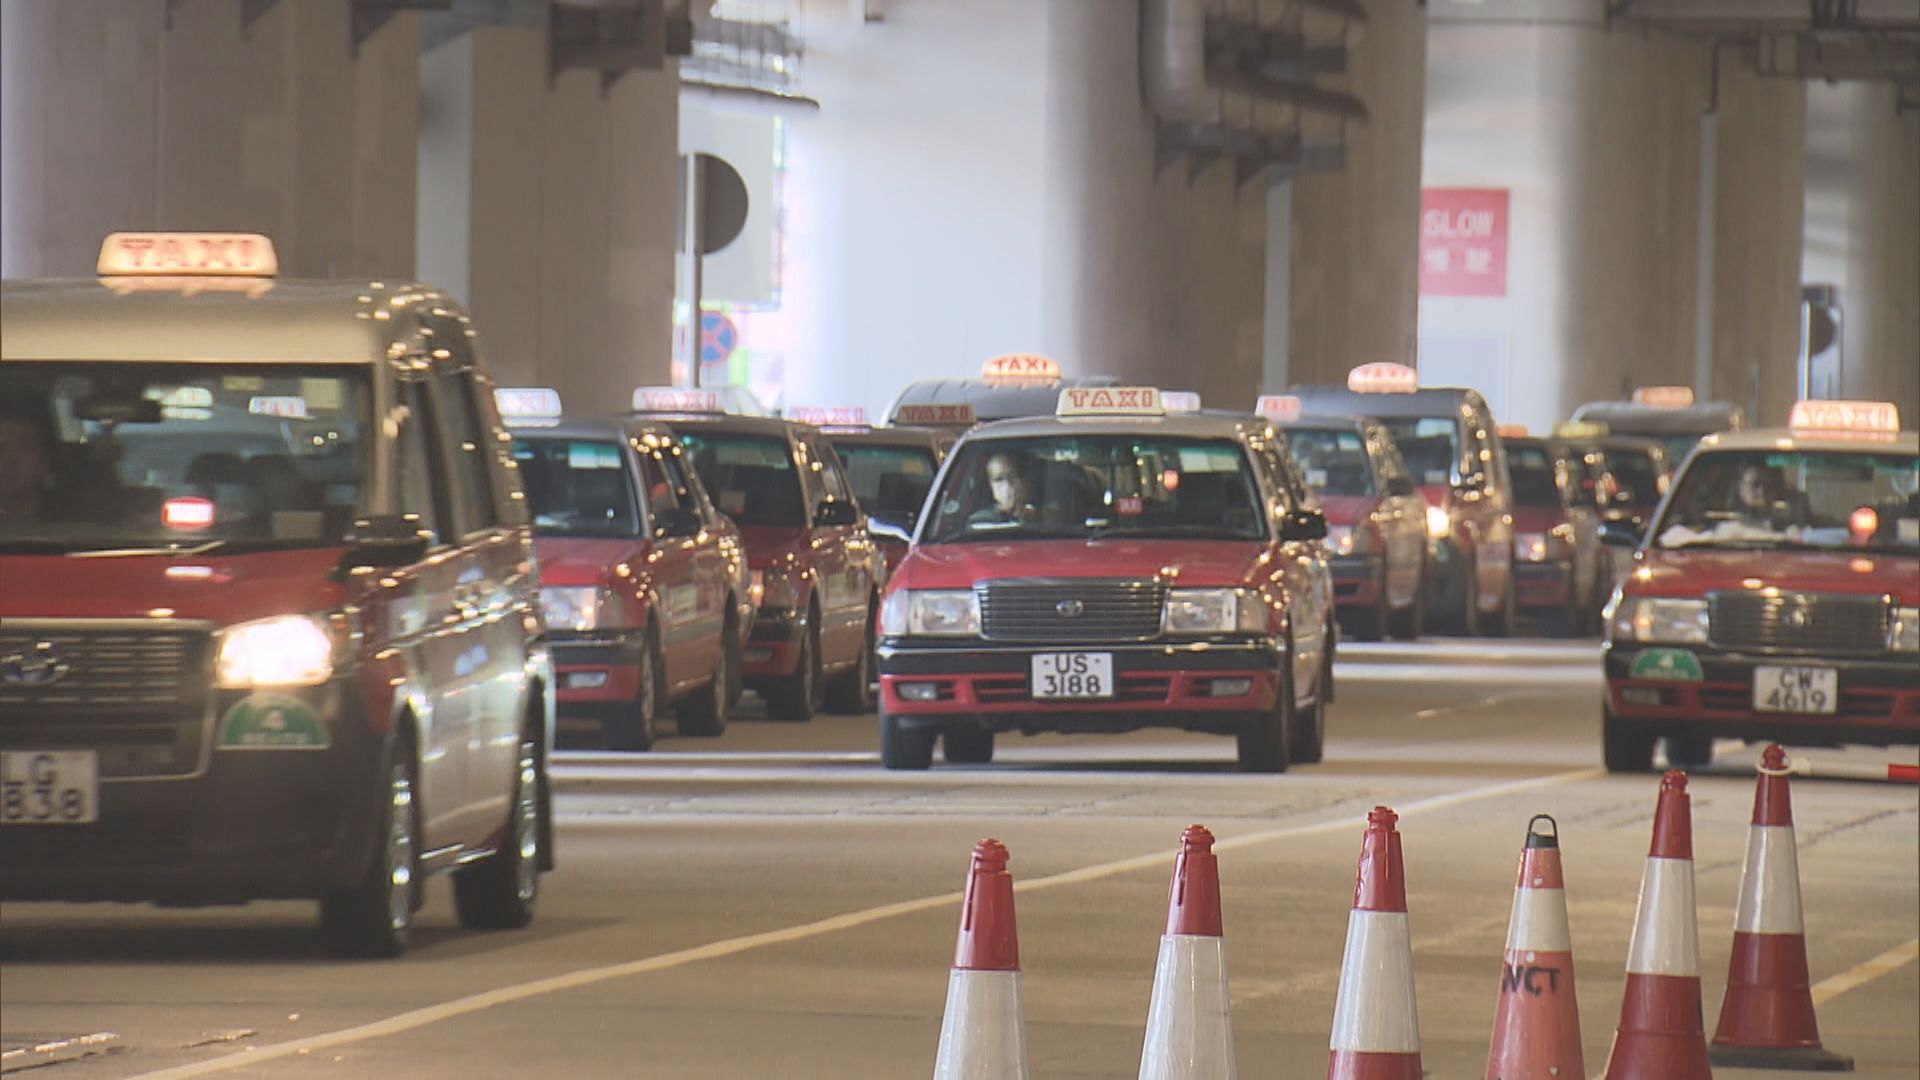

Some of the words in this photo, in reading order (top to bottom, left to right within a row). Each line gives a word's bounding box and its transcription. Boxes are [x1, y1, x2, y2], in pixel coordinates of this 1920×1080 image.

[1423, 208, 1494, 241] SLOW
[119, 238, 254, 267] TAXI
[992, 356, 1048, 371] TAXI
[641, 392, 716, 410] TAXI
[1068, 389, 1153, 408] TAXI
[791, 406, 865, 424] TAXI
[901, 405, 970, 421] TAXI
[1801, 403, 1890, 428] TAXI
[1055, 654, 1088, 674] US
[1043, 675, 1101, 695] 3188
[1779, 667, 1812, 689] CW
[1767, 689, 1826, 709] 4619
